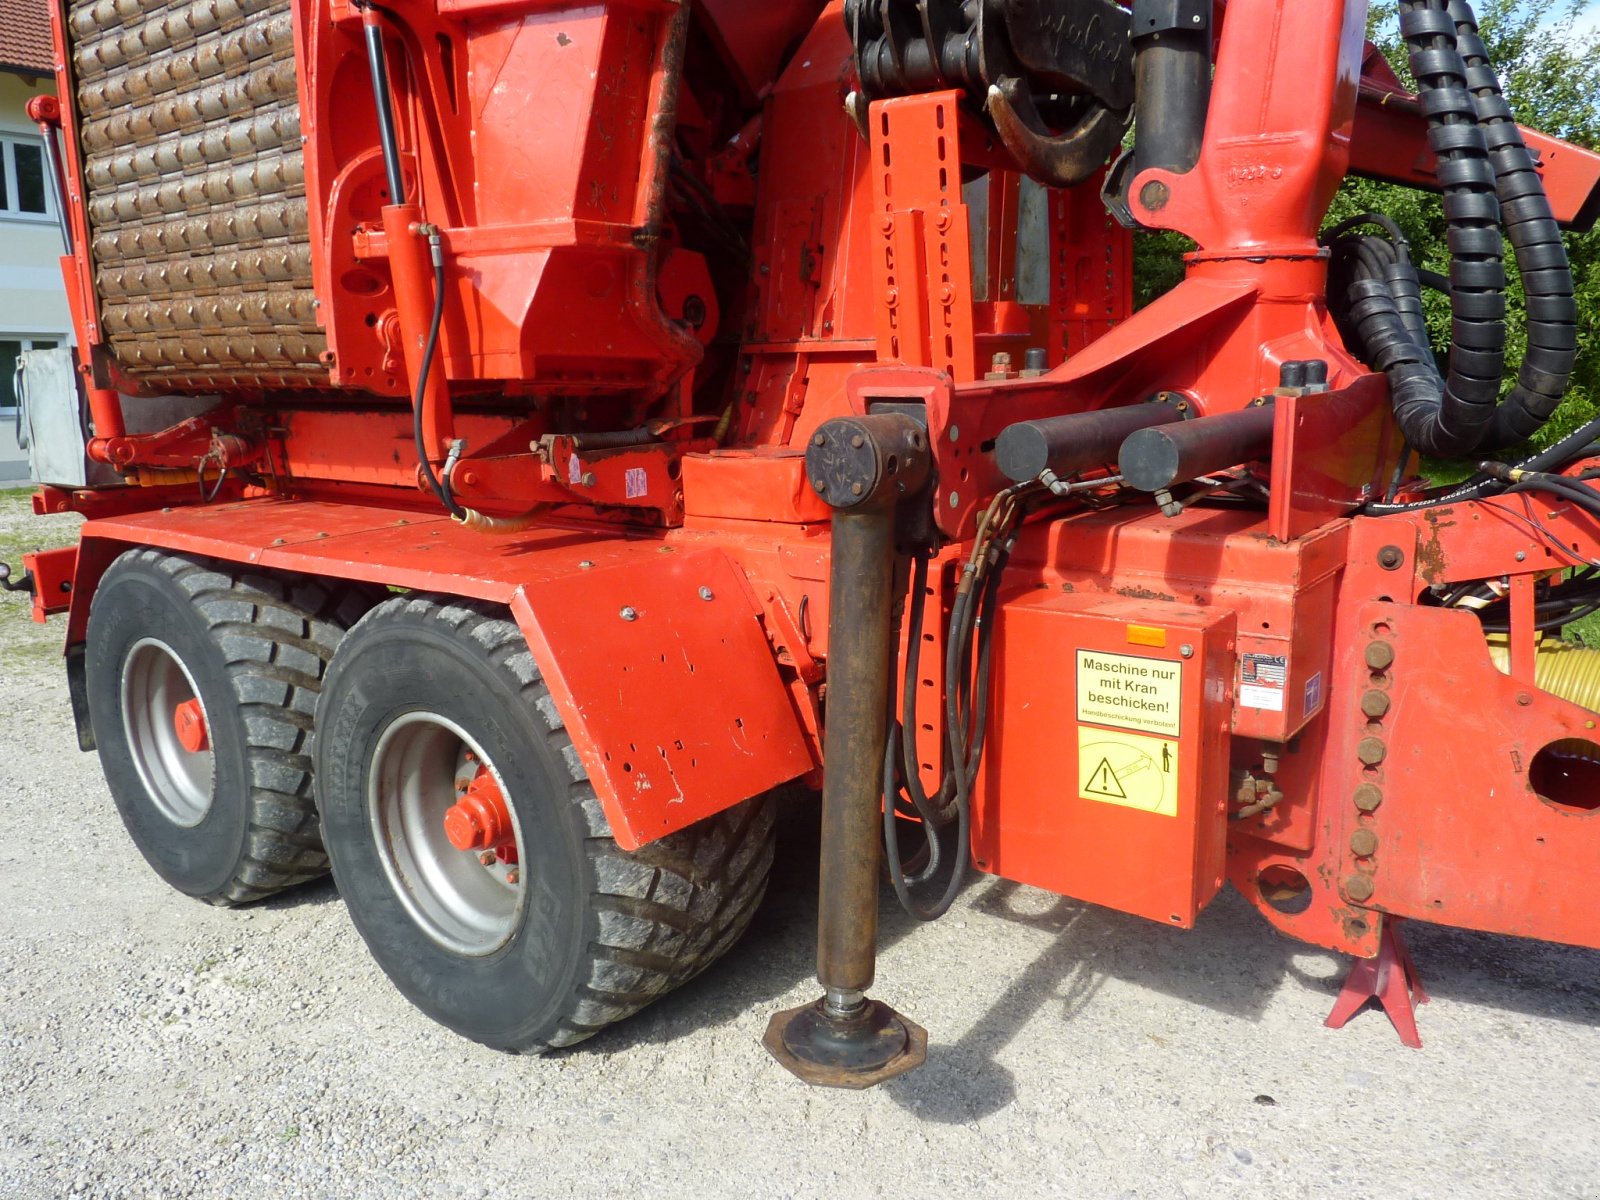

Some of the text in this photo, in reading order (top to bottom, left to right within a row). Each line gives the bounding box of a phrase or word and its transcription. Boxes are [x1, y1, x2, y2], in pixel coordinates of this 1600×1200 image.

[1083, 658, 1176, 680] Maschine nur
[1100, 678, 1157, 695] mit Kran
[1088, 691, 1169, 714] beschicken!
[1082, 708, 1176, 729] Handbeschickung verboten!
